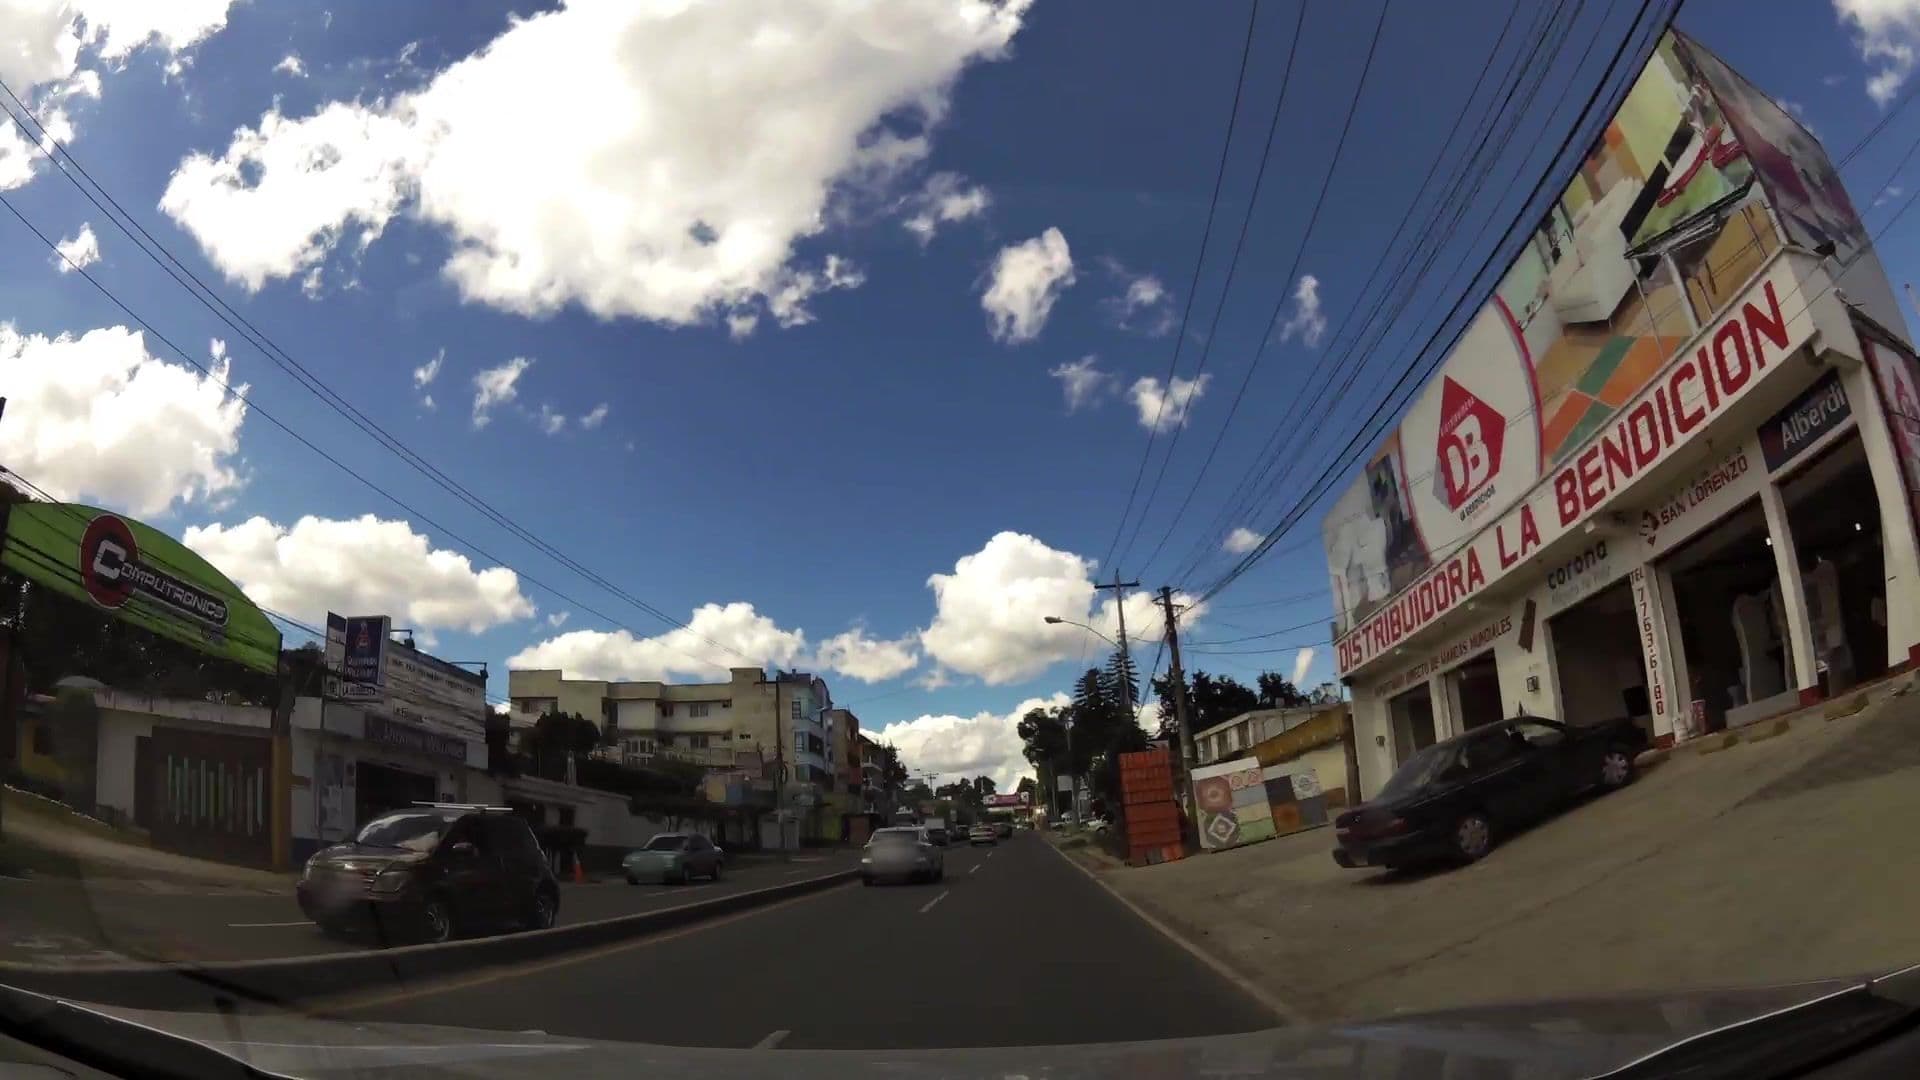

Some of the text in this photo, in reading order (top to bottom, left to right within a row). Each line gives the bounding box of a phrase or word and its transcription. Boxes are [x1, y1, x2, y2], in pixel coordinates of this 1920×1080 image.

[1781, 383, 1847, 450] Alberdi
[1338, 546, 1485, 674] DISTRIBUIDORA
[1496, 503, 1541, 571] LA
[1554, 279, 1790, 528] BENDICION
[1446, 413, 1490, 494] DB
[1660, 502, 1689, 526] SAN
[1689, 454, 1749, 508] LORENZO
[93, 539, 226, 619] COMPUTRONICS
[1548, 540, 1608, 589] corona
[1630, 567, 1644, 585] TEL
